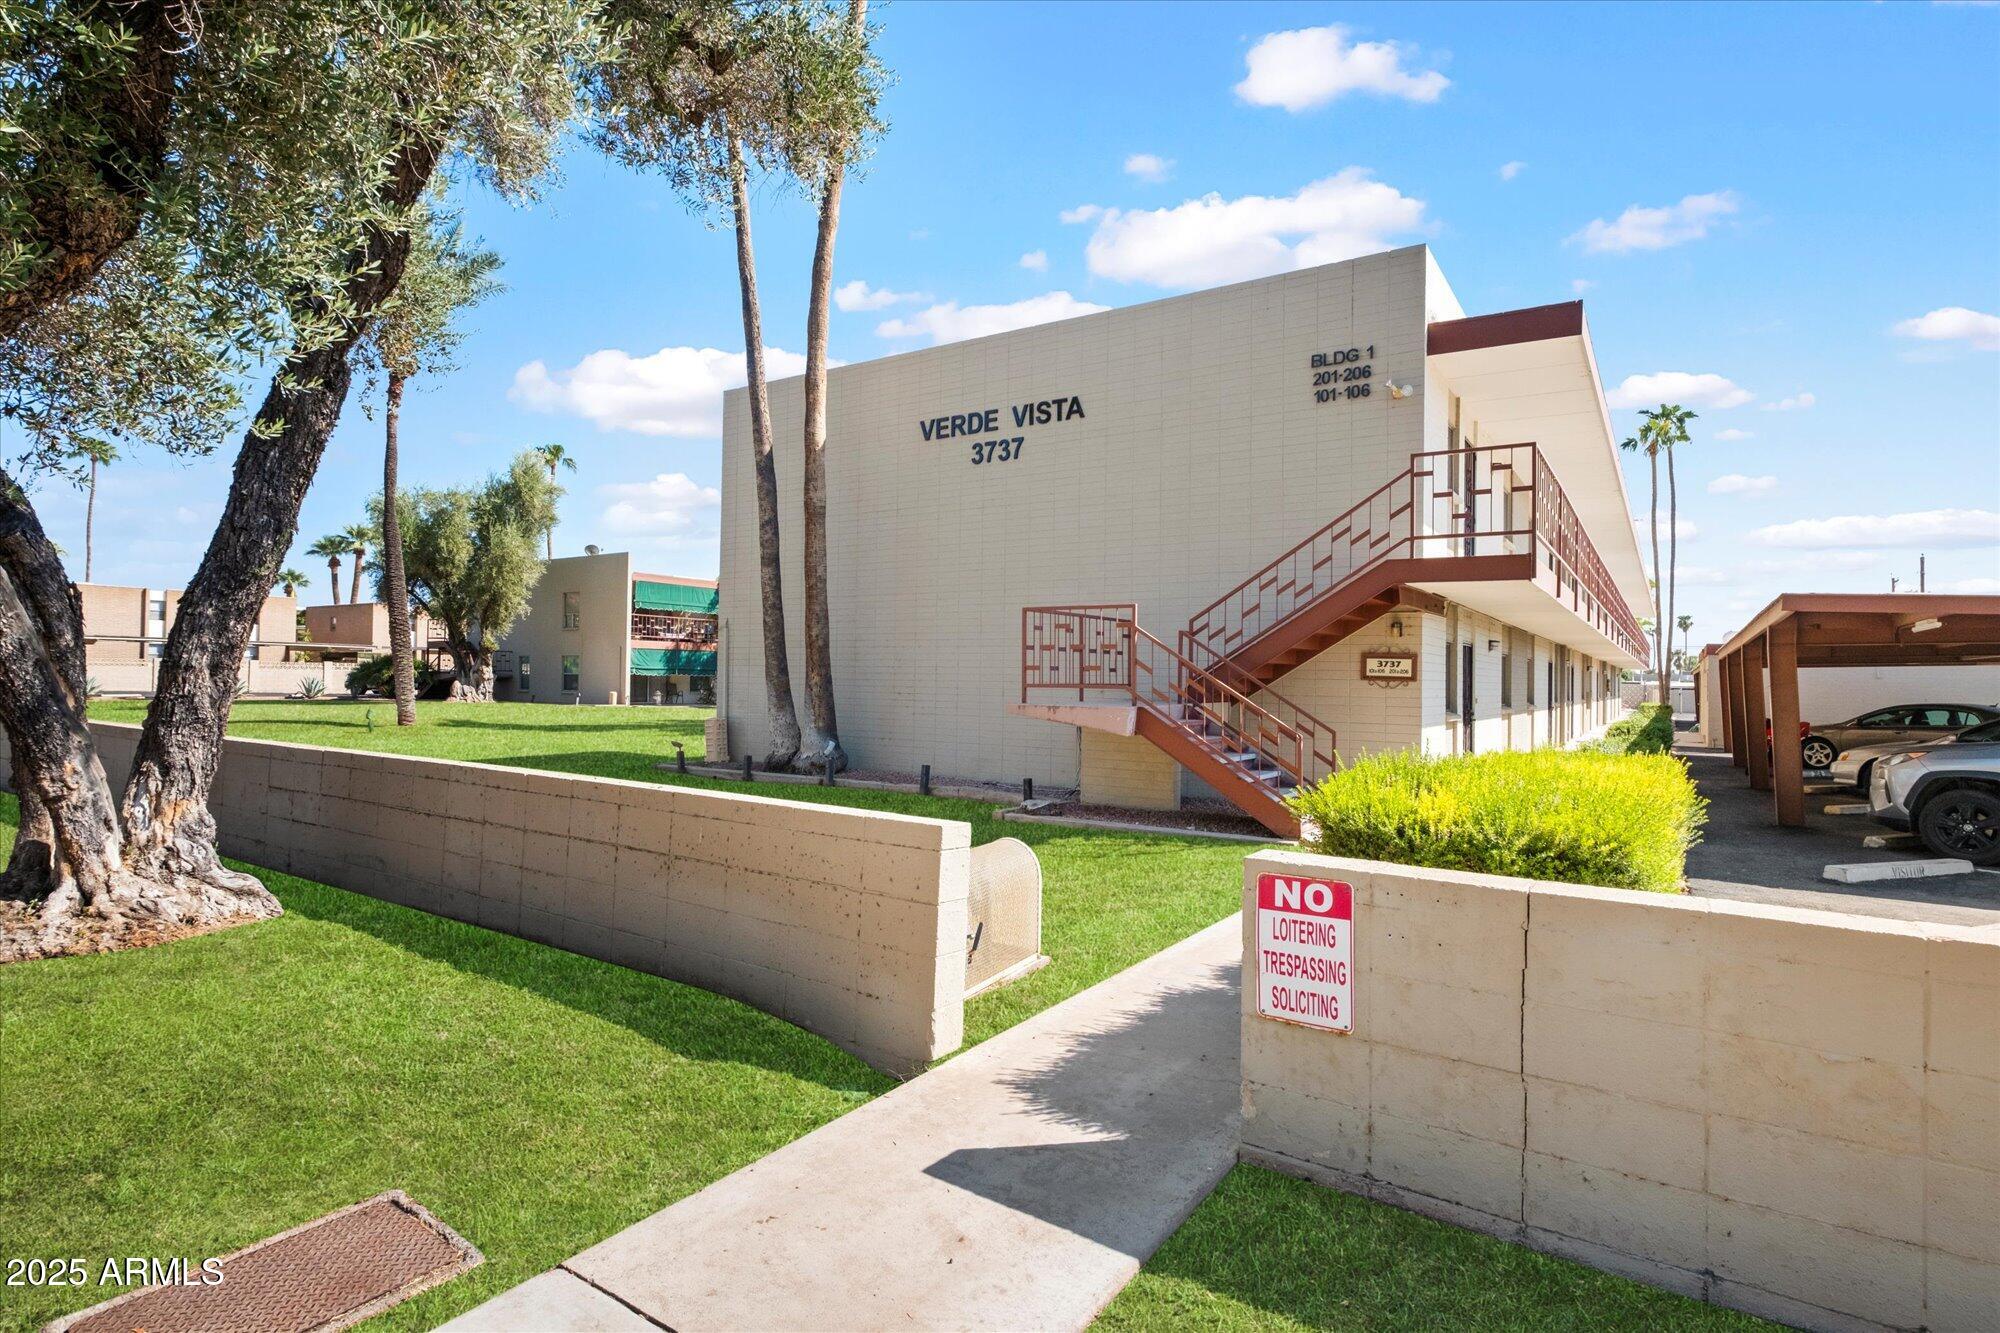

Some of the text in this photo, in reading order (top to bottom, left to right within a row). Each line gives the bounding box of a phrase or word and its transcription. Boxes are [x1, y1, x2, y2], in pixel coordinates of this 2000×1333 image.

[1311, 344, 1375, 368] BLDG 1
[1312, 364, 1372, 386] 201-206
[1314, 383, 1371, 403] 101-106
[919, 395, 1086, 441] VERDE VISTA
[971, 436, 1025, 465] 3737
[1376, 660, 1402, 668] 3737
[1274, 878, 1334, 913] NO
[1272, 916, 1337, 949] LOITERING
[1263, 950, 1347, 986] TRESPASSING
[1272, 985, 1339, 1020] SOLICITING
